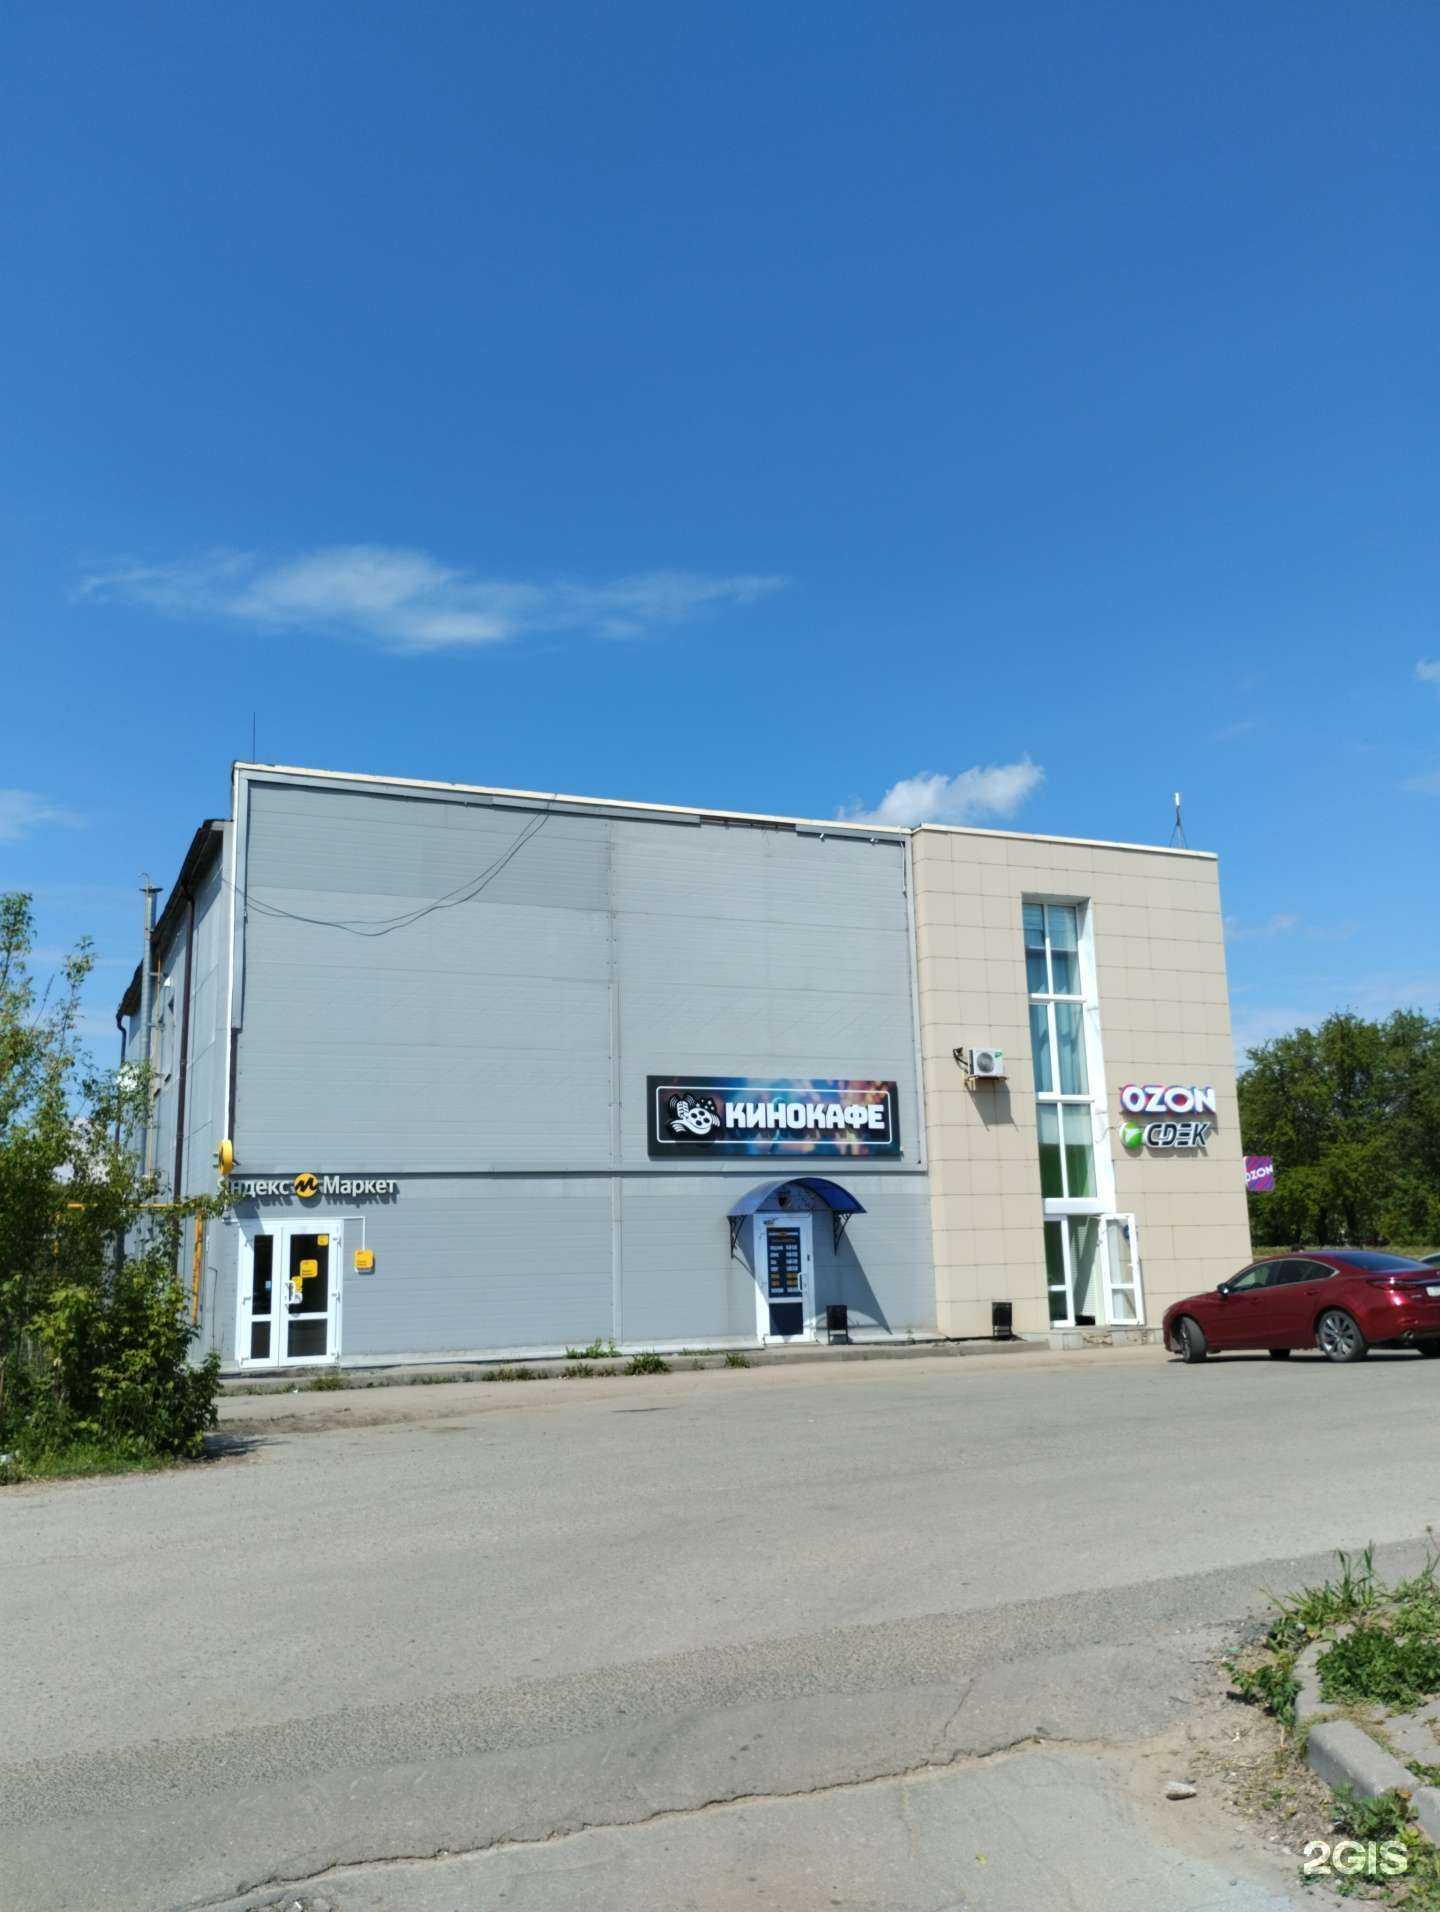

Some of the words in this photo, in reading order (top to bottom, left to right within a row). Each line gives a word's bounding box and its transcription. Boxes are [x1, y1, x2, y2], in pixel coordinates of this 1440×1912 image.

[1121, 1085, 1217, 1114] OZON
[725, 1102, 886, 1130] КИНОКАФЕ
[1144, 1122, 1210, 1148] CDEK
[322, 1175, 399, 1196] Маркет
